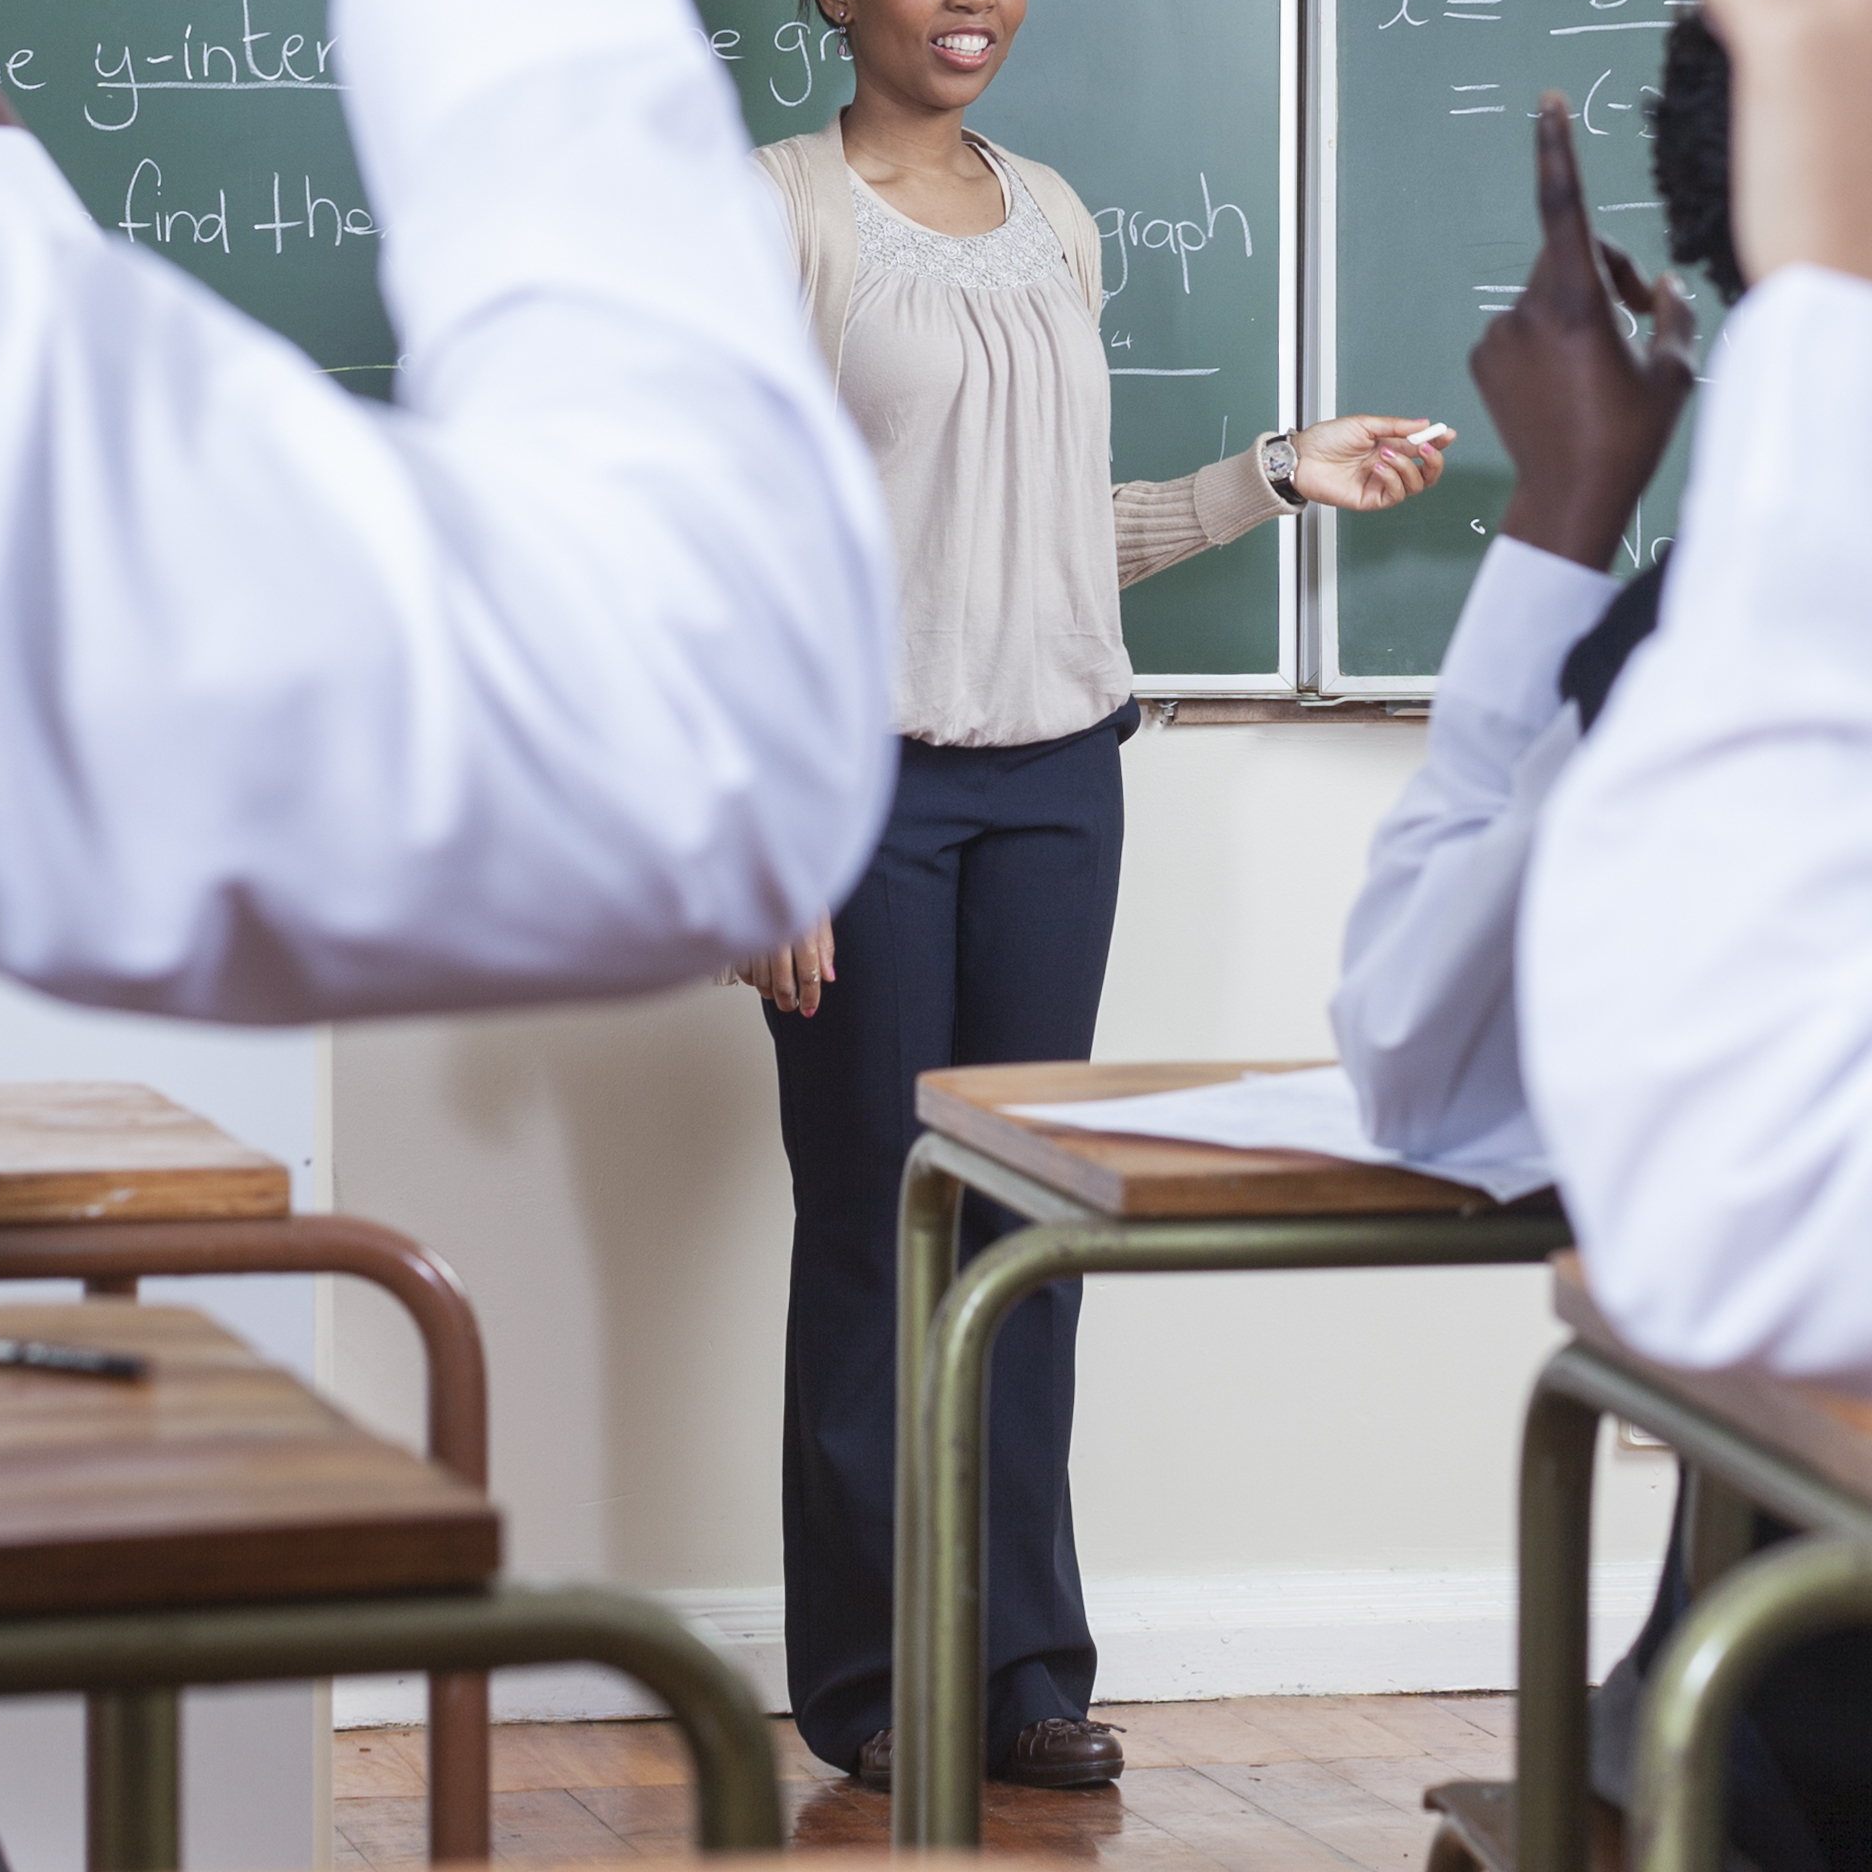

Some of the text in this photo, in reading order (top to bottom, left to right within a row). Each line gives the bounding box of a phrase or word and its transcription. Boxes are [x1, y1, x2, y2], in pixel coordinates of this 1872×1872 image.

[117, 157, 1253, 296] find the graph
